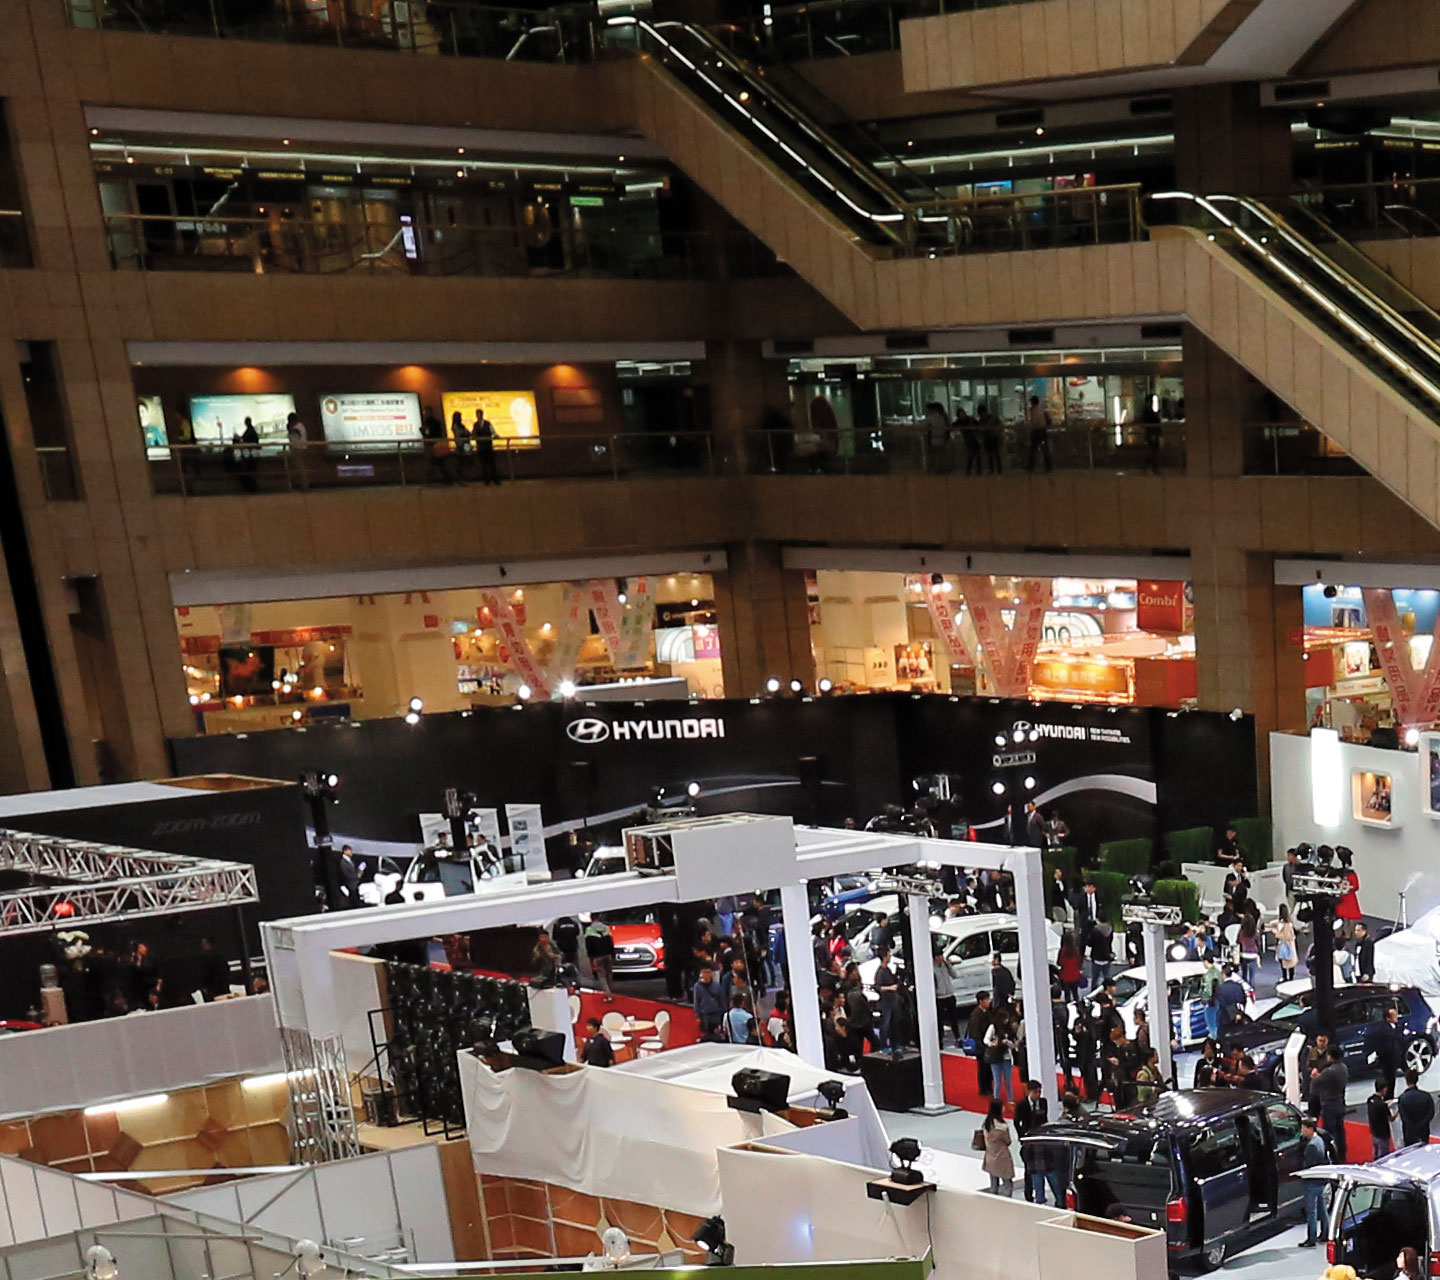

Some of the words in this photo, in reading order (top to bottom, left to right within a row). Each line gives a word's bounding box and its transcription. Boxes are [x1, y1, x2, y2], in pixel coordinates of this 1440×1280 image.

[1138, 592, 1178, 607] Combi
[612, 718, 725, 740] HYUNDAI
[1035, 723, 1086, 741] HYUNDAI
